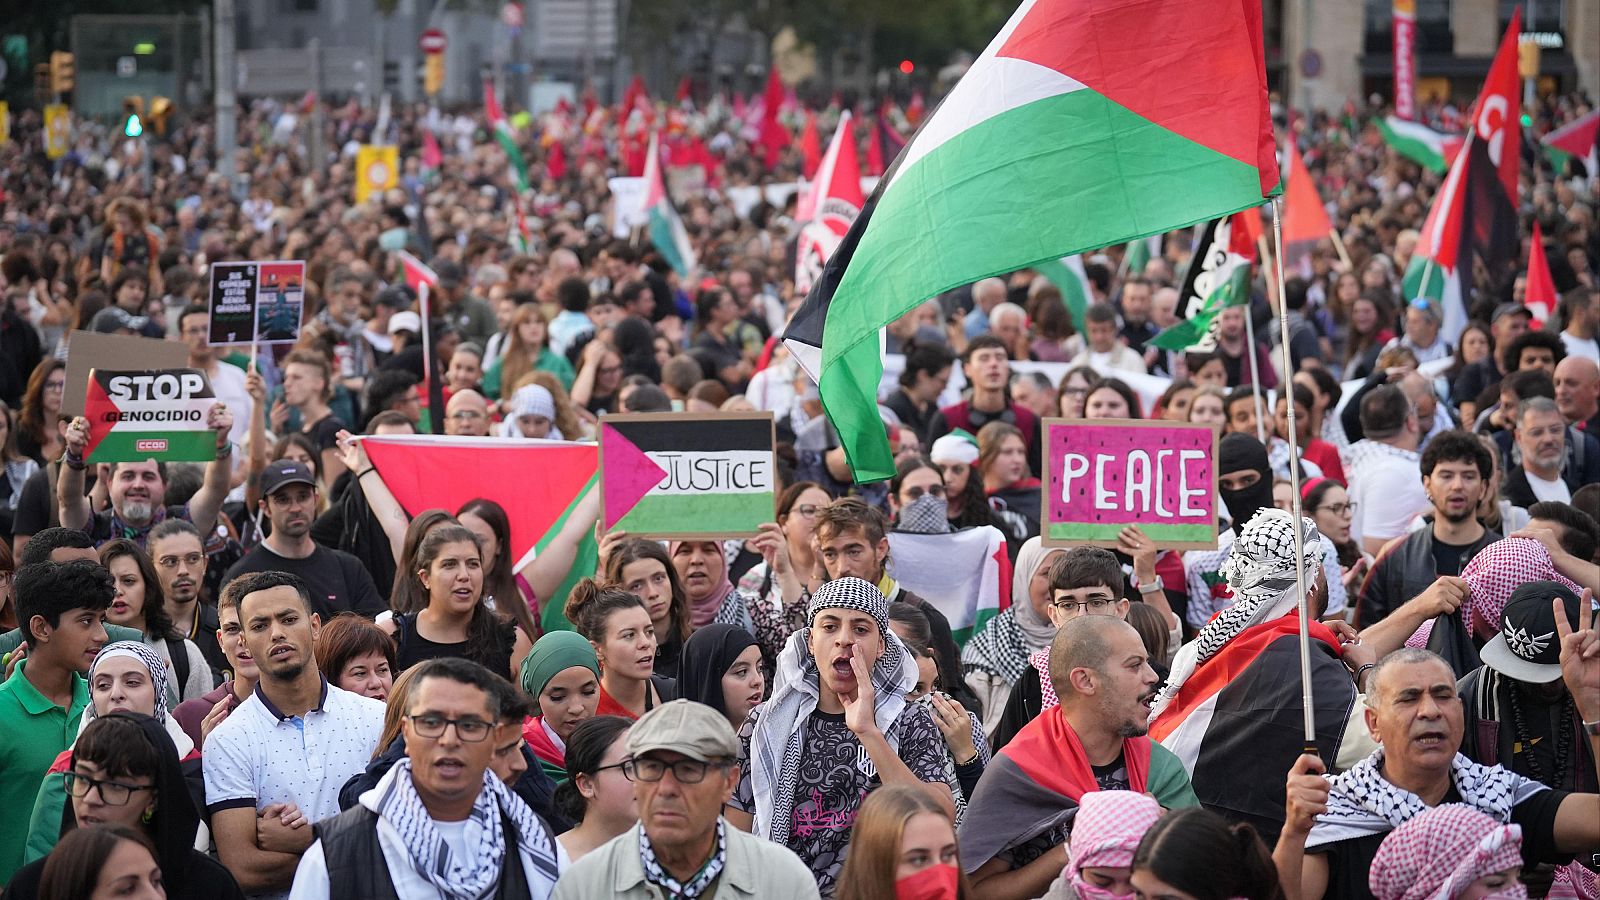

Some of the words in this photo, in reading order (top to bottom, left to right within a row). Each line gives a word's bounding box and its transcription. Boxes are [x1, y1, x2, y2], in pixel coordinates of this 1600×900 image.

[109, 374, 204, 400] STOP
[104, 410, 202, 421] GENOCIDIO
[138, 441, 166, 449] CCOO
[1061, 449, 1208, 518] PEACE
